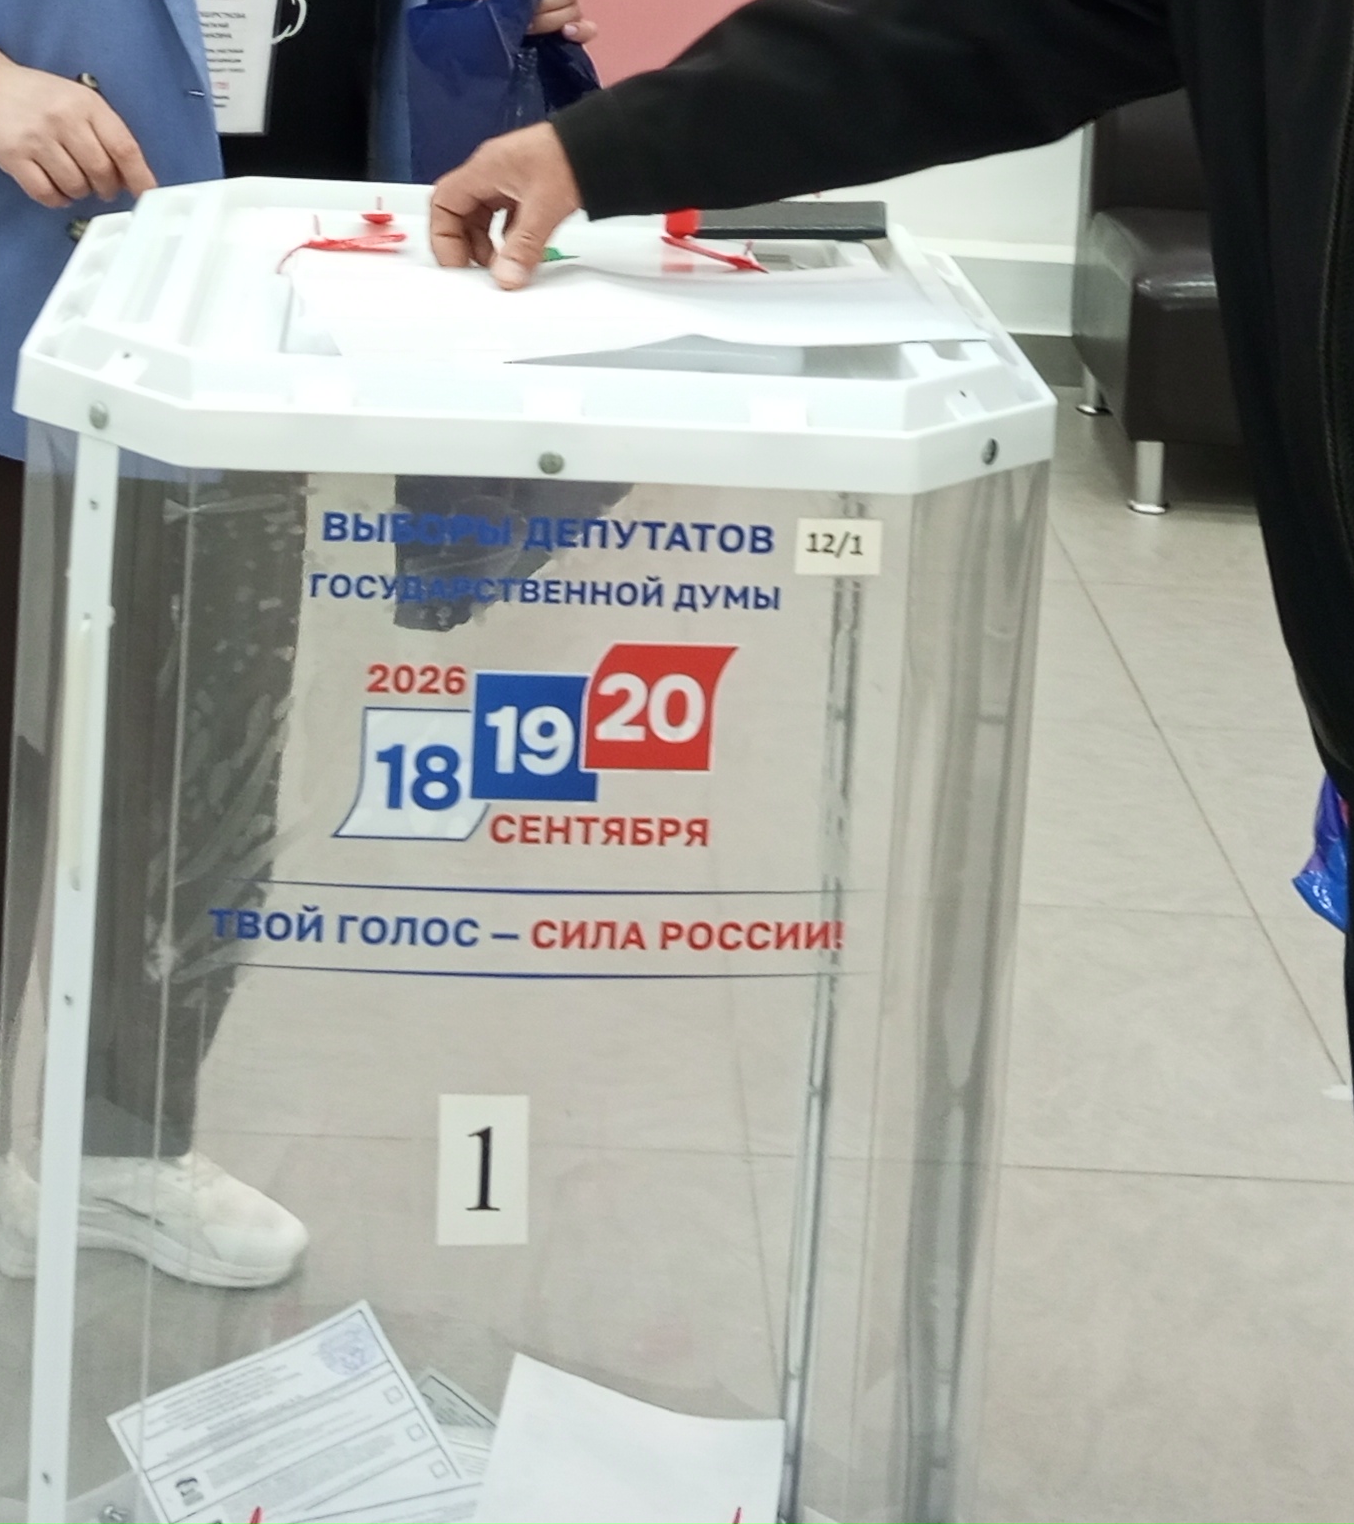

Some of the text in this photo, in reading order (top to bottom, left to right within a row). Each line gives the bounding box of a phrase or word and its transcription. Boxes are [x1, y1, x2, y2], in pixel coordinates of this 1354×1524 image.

[323, 512, 775, 554] ВЫБОРЫ ДЕПУТАТОВ
[806, 532, 864, 557] 12/1
[309, 574, 781, 612] ГОСУДАРСТВЕННОЙ ДУМЫ
[367, 665, 467, 695] 2026
[376, 674, 705, 811] 18 19 20
[490, 815, 710, 847] СЕНТЯБРЯ
[209, 905, 324, 942] ТВОЙ
[338, 917, 480, 947] ГОЛОС
[531, 920, 646, 950] СИЛА
[660, 922, 843, 951] РОССИИ!
[466, 1126, 501, 1211] 1
